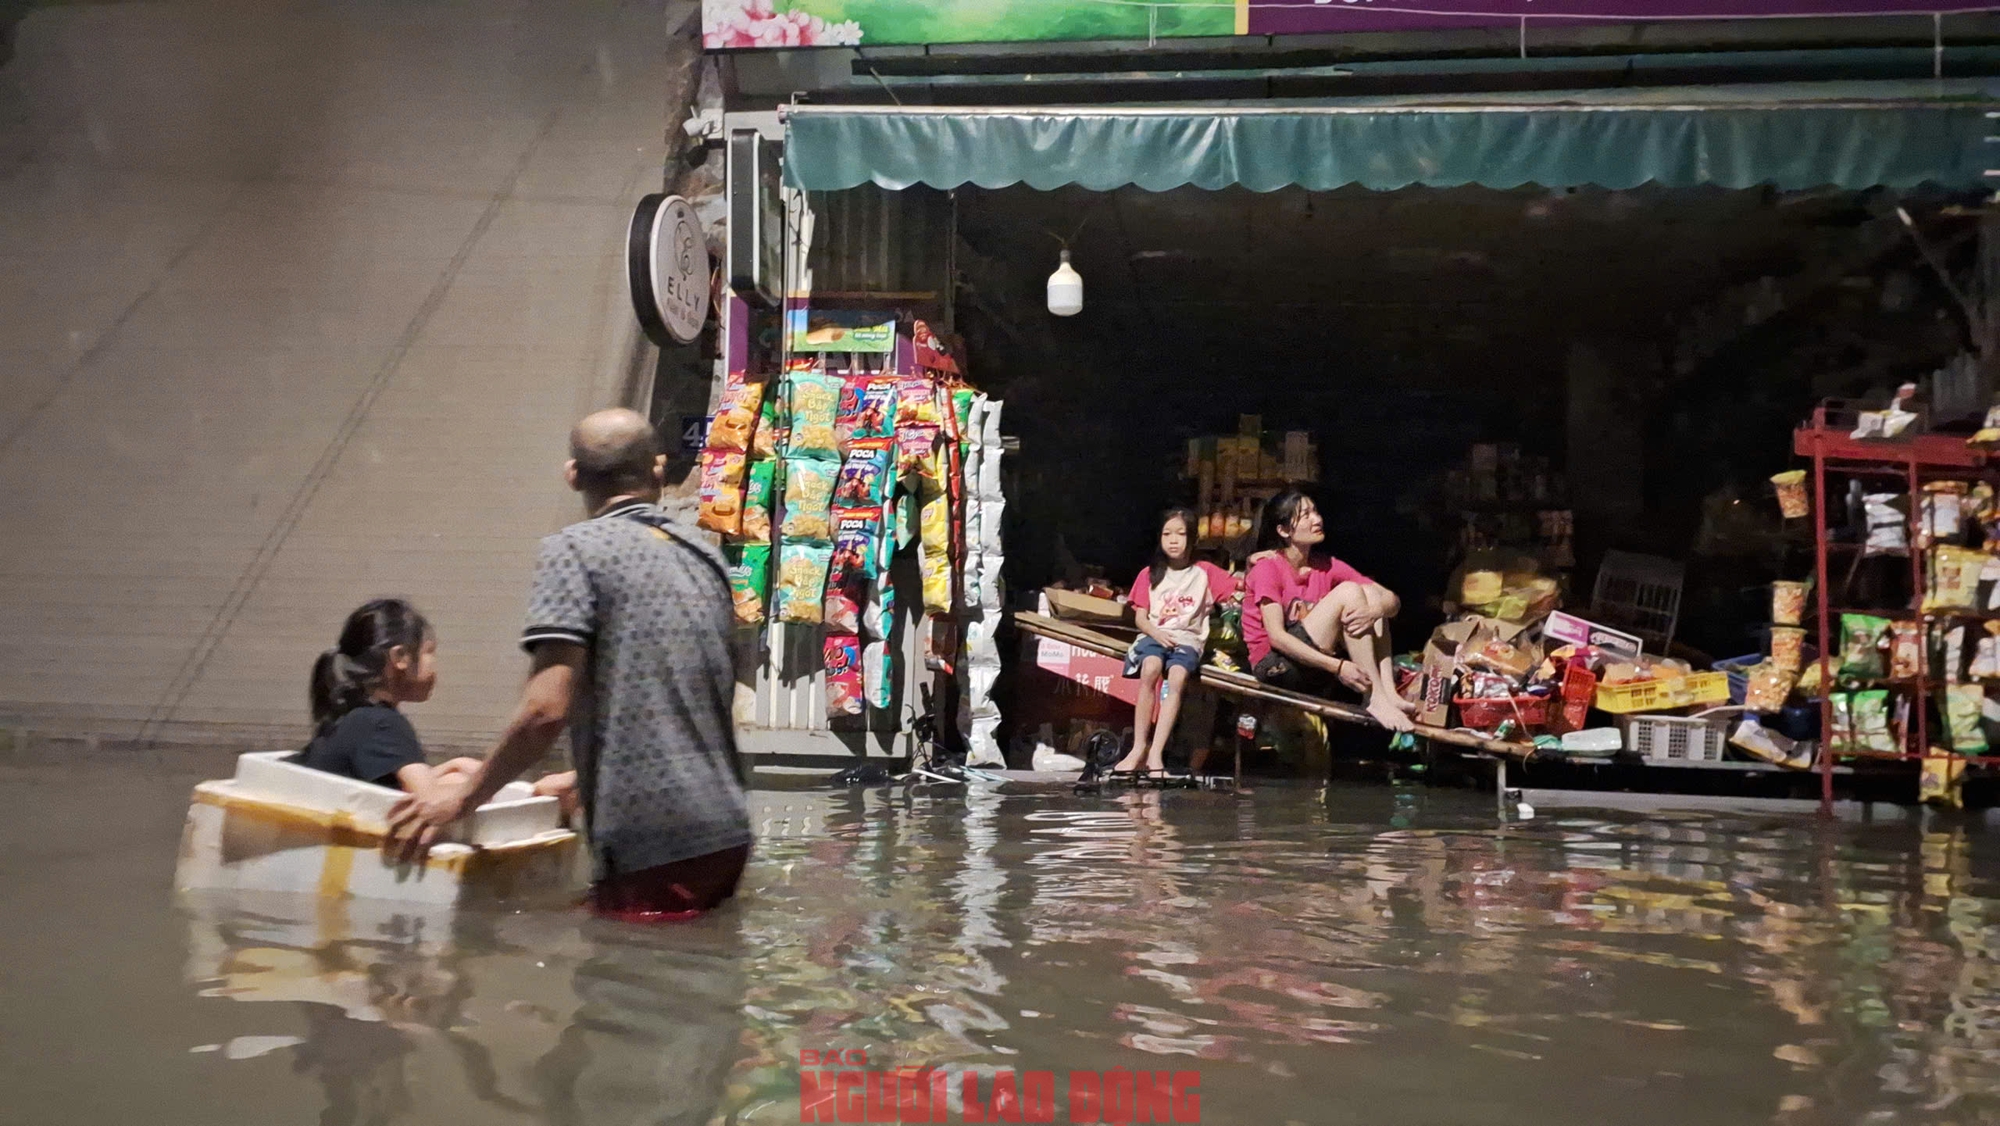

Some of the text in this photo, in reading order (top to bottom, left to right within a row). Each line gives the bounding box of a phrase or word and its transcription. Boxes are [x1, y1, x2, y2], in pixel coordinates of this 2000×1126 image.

[667, 276, 700, 311] ELLY
[849, 449, 875, 459] POCA
[840, 519, 864, 530] POCA
